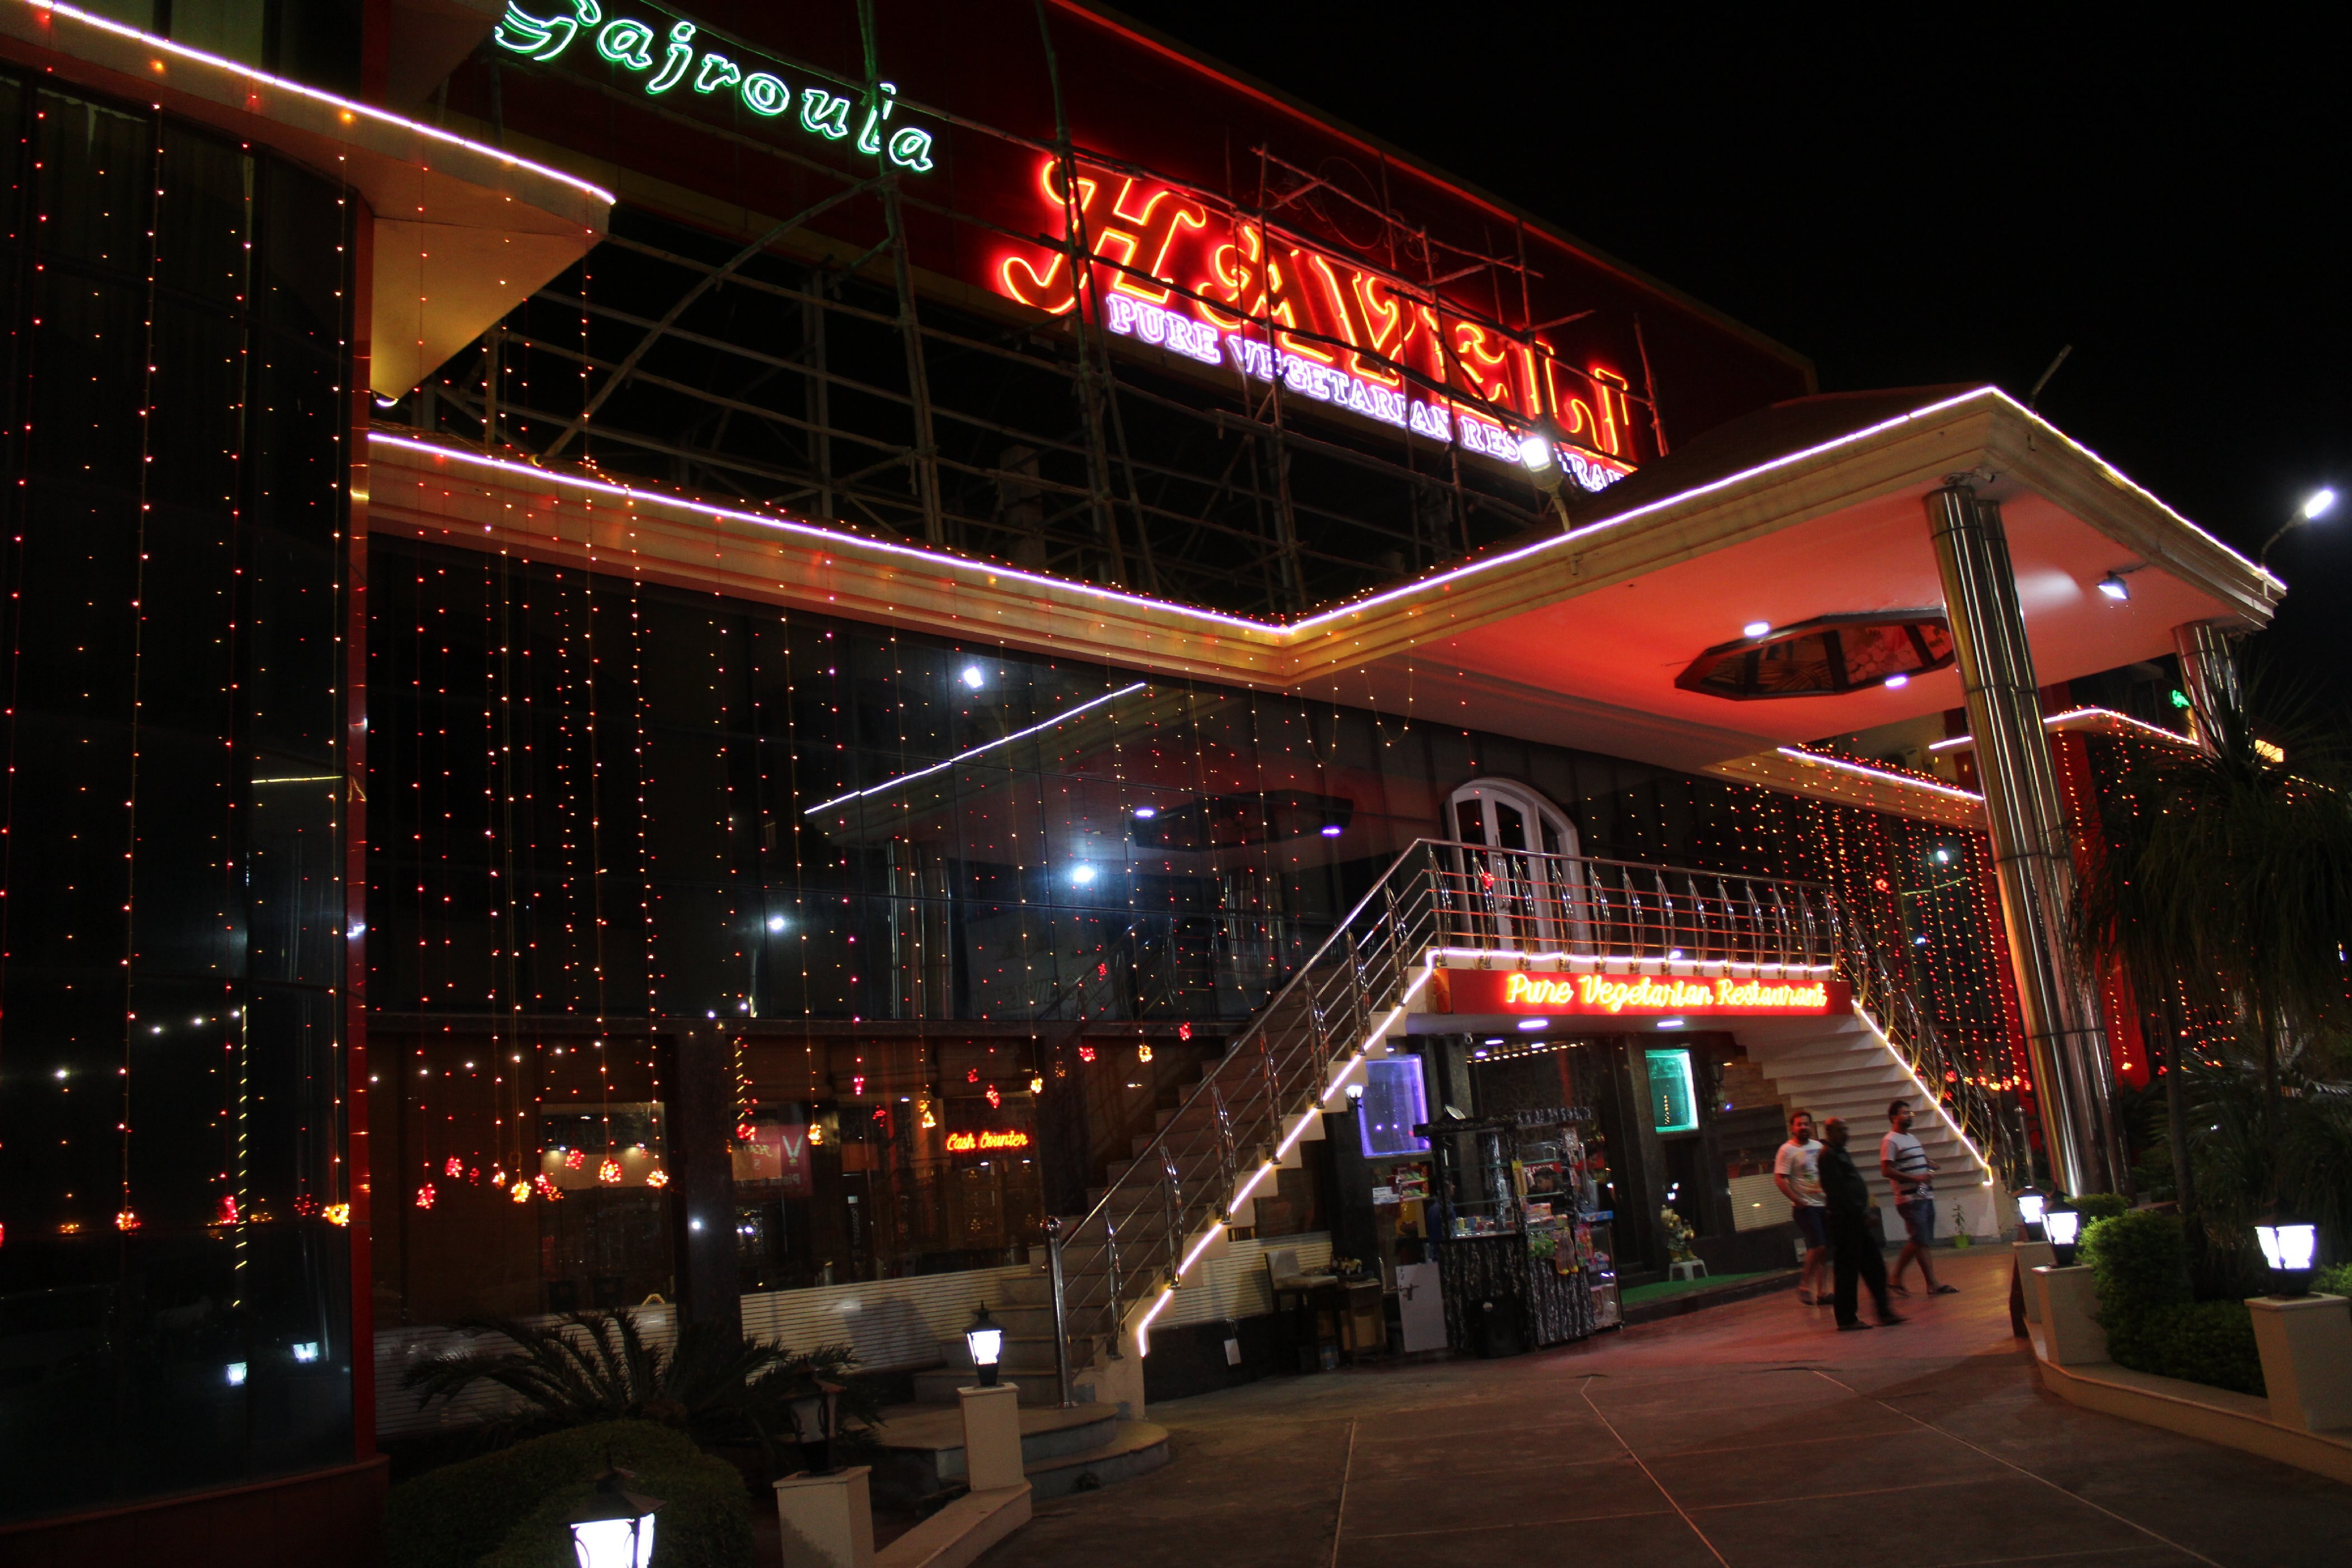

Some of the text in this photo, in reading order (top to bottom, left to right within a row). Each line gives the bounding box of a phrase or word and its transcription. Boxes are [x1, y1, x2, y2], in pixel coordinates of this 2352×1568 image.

[1106, 292, 1222, 366] PURE
[1225, 334, 1454, 442] VEGETARIAN
[1506, 973, 1828, 1013] Pure Vegetarian Restaurant
[946, 1130, 1028, 1151] Cash Counter
